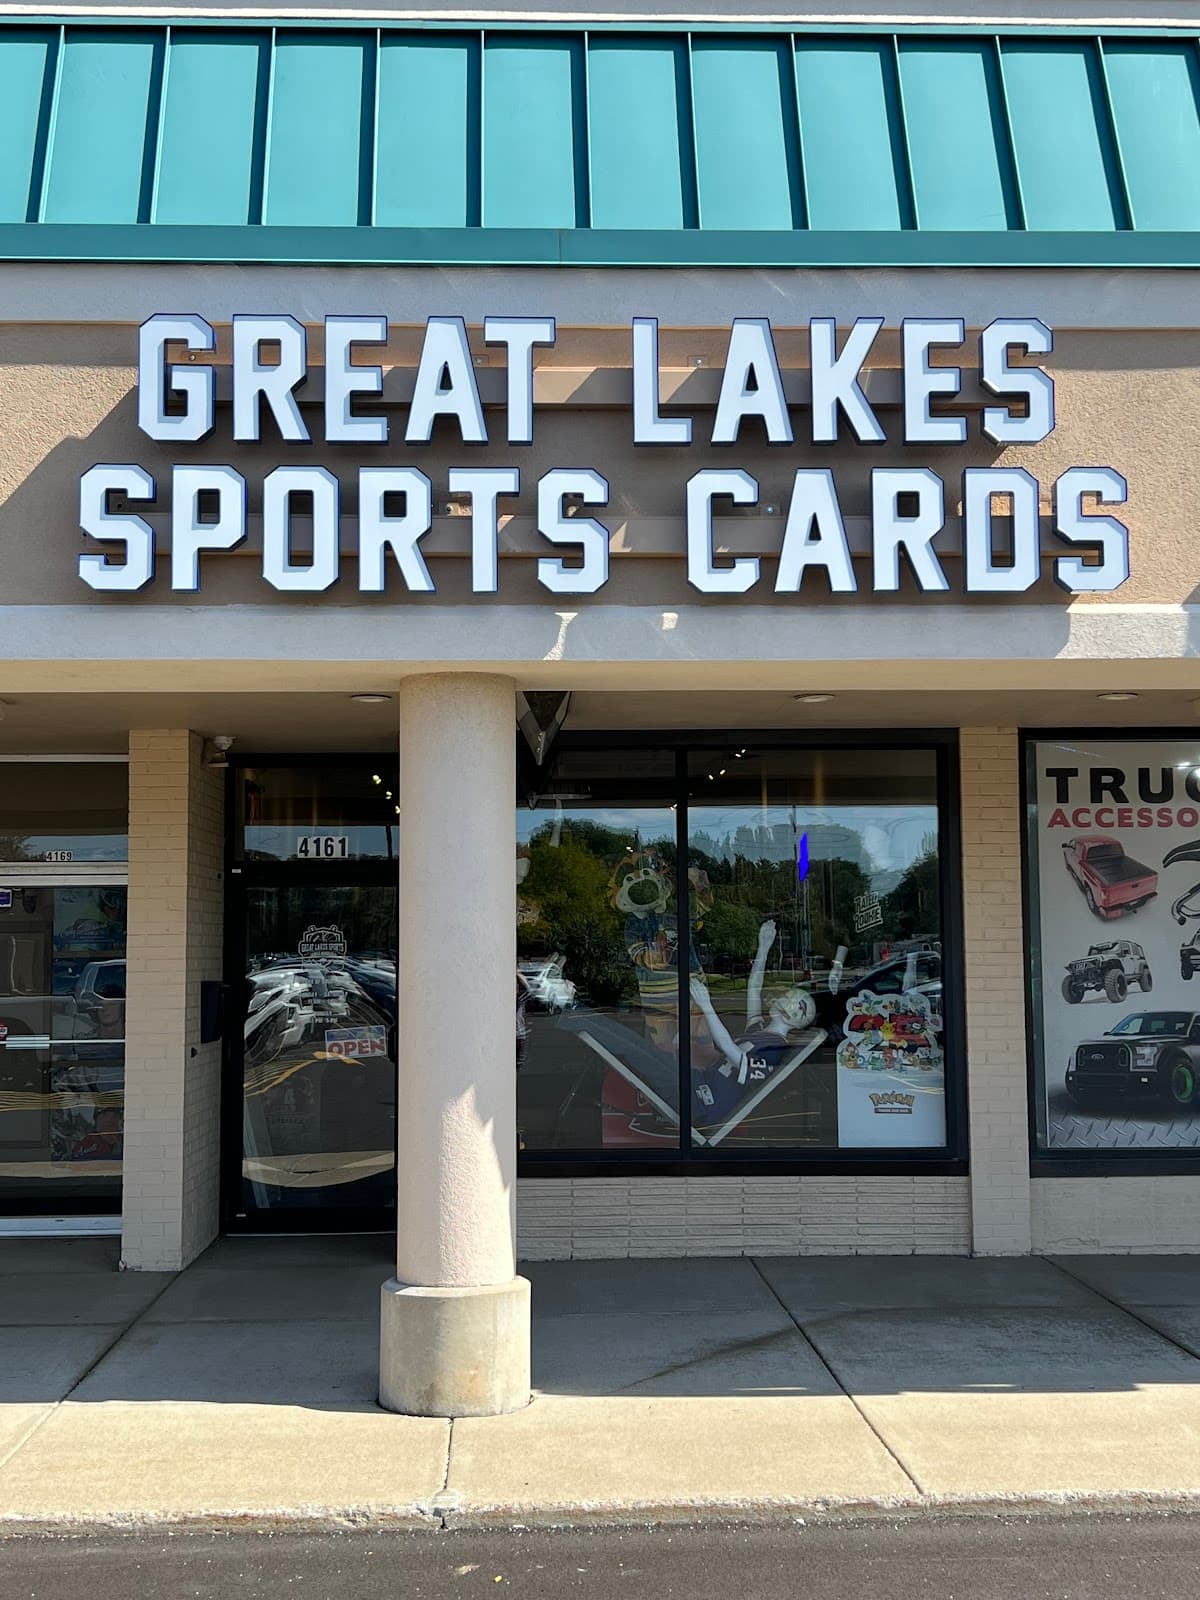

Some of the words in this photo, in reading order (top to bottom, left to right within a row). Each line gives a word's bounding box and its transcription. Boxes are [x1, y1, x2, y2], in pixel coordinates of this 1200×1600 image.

[138, 313, 556, 445] GREAT
[632, 317, 1055, 446] LAKES
[78, 463, 610, 593] SPORTS
[686, 466, 1129, 593] CARDS
[1047, 807, 1199, 828] ACCESSO
[46, 851, 72, 860] 4169
[299, 837, 346, 857] 4161
[327, 1038, 385, 1056] OPEN
